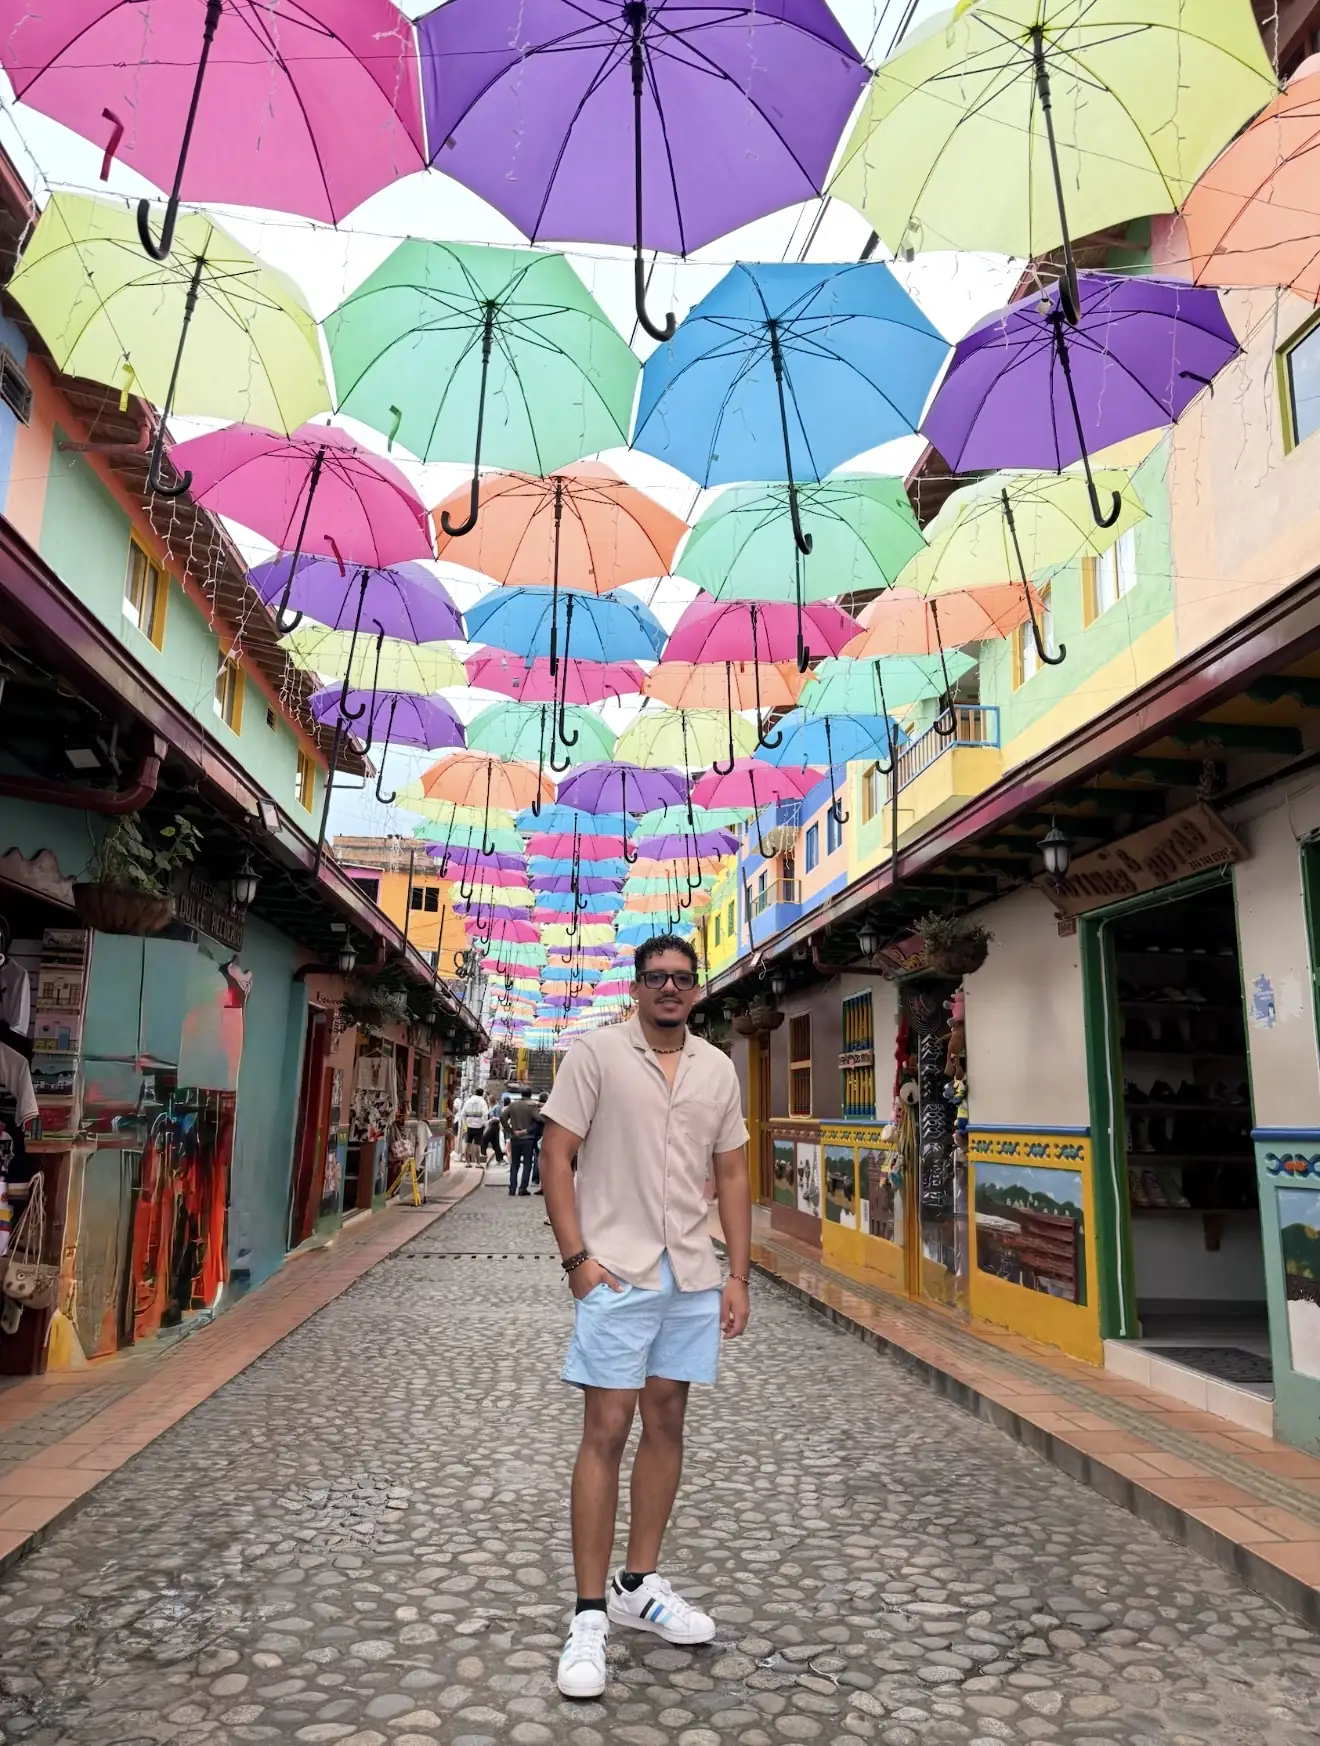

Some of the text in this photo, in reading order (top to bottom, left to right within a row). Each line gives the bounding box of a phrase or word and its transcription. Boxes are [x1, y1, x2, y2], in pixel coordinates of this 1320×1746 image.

[1115, 848, 1142, 873] &
[1146, 820, 1207, 884] BOTAS
[178, 894, 207, 930] DULCE
